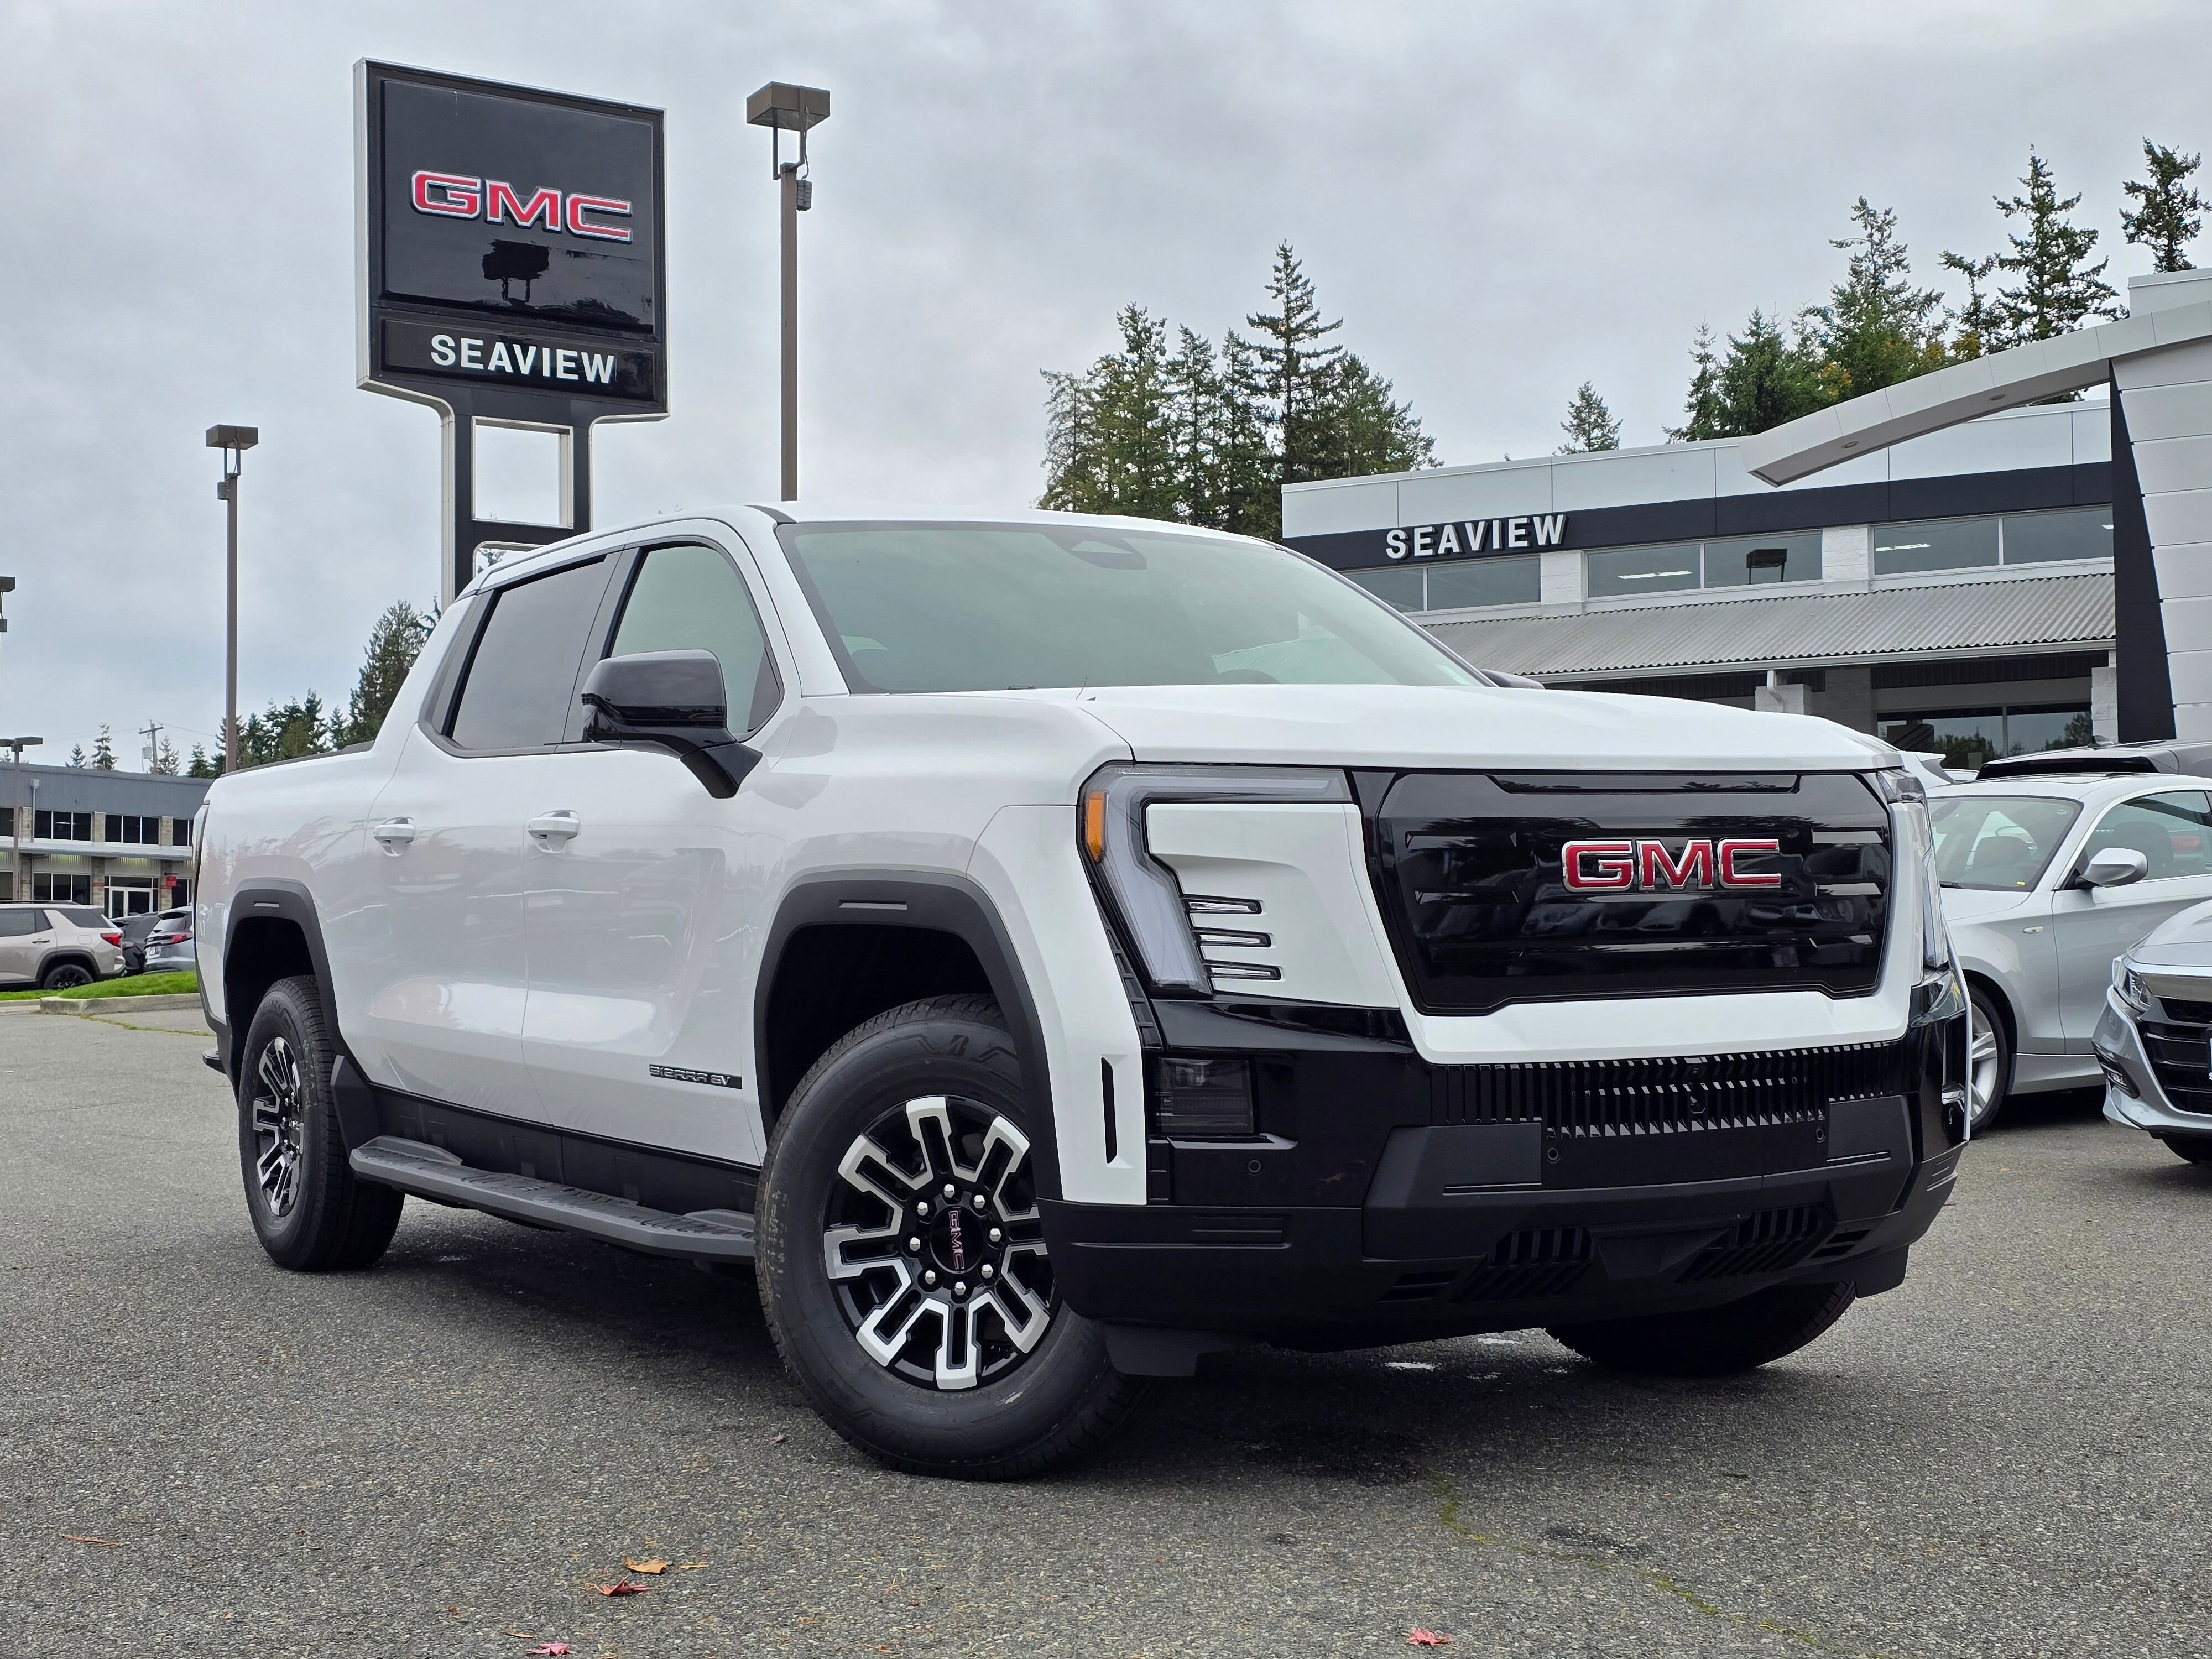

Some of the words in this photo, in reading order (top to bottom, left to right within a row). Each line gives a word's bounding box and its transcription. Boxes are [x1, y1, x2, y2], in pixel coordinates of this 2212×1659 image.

[410, 170, 633, 243] GMC
[431, 334, 615, 383] SEAVIEW
[1386, 514, 1566, 560] SEAVIEW
[1561, 838, 1781, 893] GMC
[649, 1066, 707, 1083] SIERRA
[711, 1074, 731, 1086] EV
[948, 1210, 965, 1270] GMC
